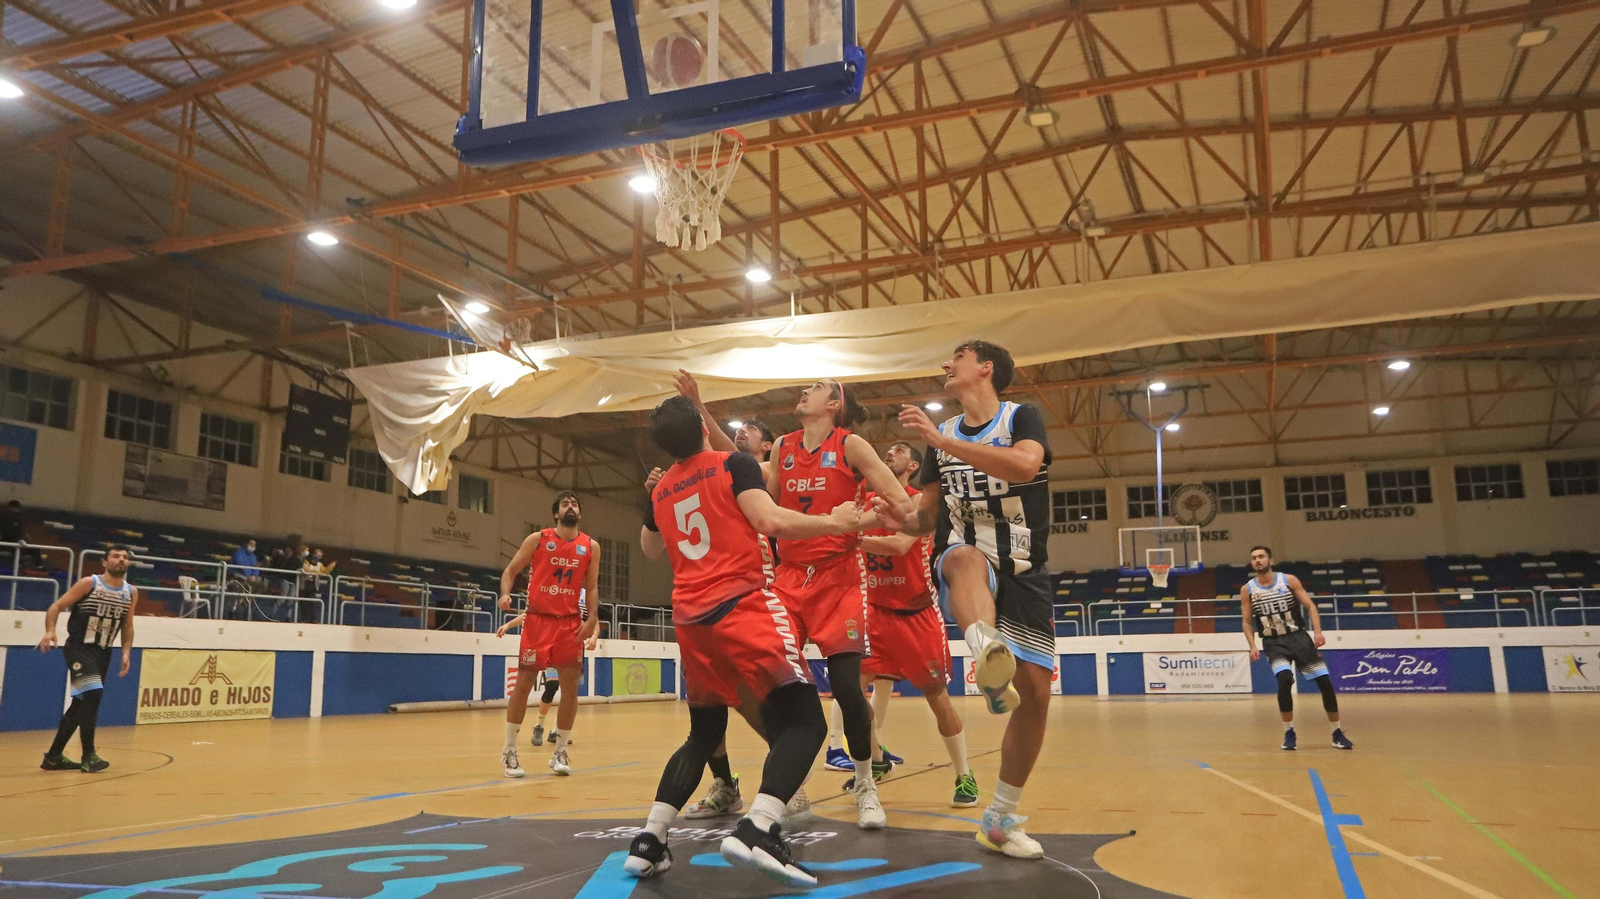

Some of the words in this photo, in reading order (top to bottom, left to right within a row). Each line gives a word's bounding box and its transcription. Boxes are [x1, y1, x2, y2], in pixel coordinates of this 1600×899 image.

[798, 496, 812, 514] 7
[1306, 506, 1415, 522] BALONCESTO
[673, 492, 711, 560] 5
[1048, 523, 1088, 534] NION
[1163, 530, 1229, 543] LINENSE
[866, 552, 893, 571] 83
[553, 568, 574, 584] 11
[868, 574, 906, 588] SUPER
[1159, 656, 1235, 669] Sumitecni
[1342, 659, 1391, 679] Don
[1393, 655, 1438, 675] Pablo
[140, 687, 202, 707] AMADO
[210, 689, 219, 705] e
[226, 686, 271, 705] HIJOS
